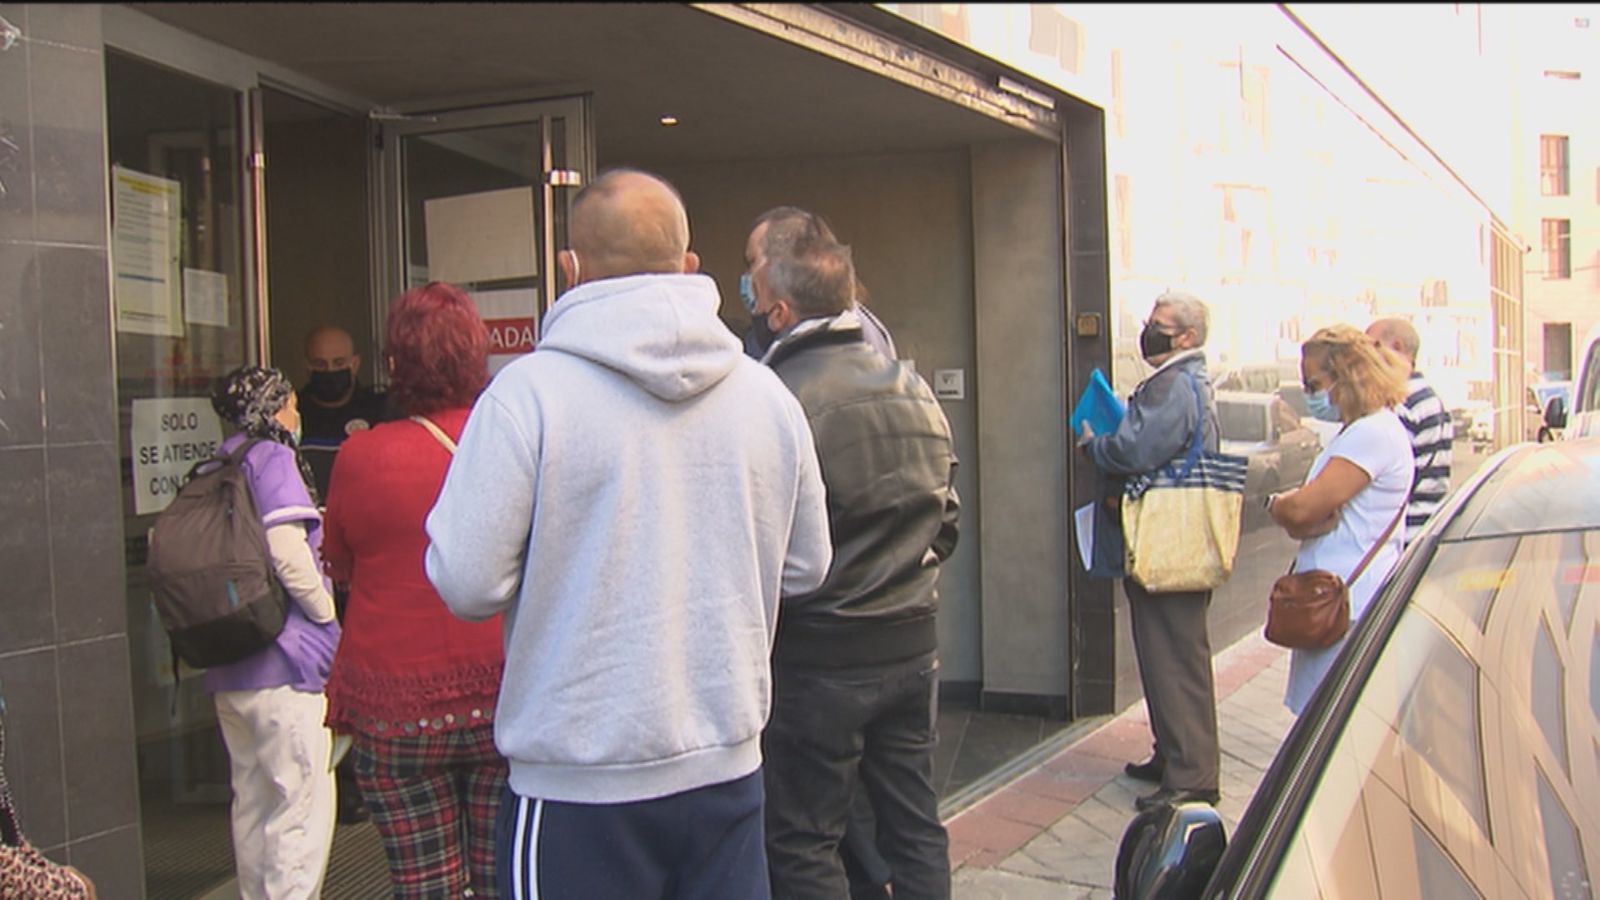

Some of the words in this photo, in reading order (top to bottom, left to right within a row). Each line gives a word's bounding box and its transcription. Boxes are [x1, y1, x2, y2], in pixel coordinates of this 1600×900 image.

[161, 412, 199, 431] SOLO
[139, 446, 160, 465] SE
[162, 441, 217, 463] ATIENDE
[150, 475, 180, 496] CON
